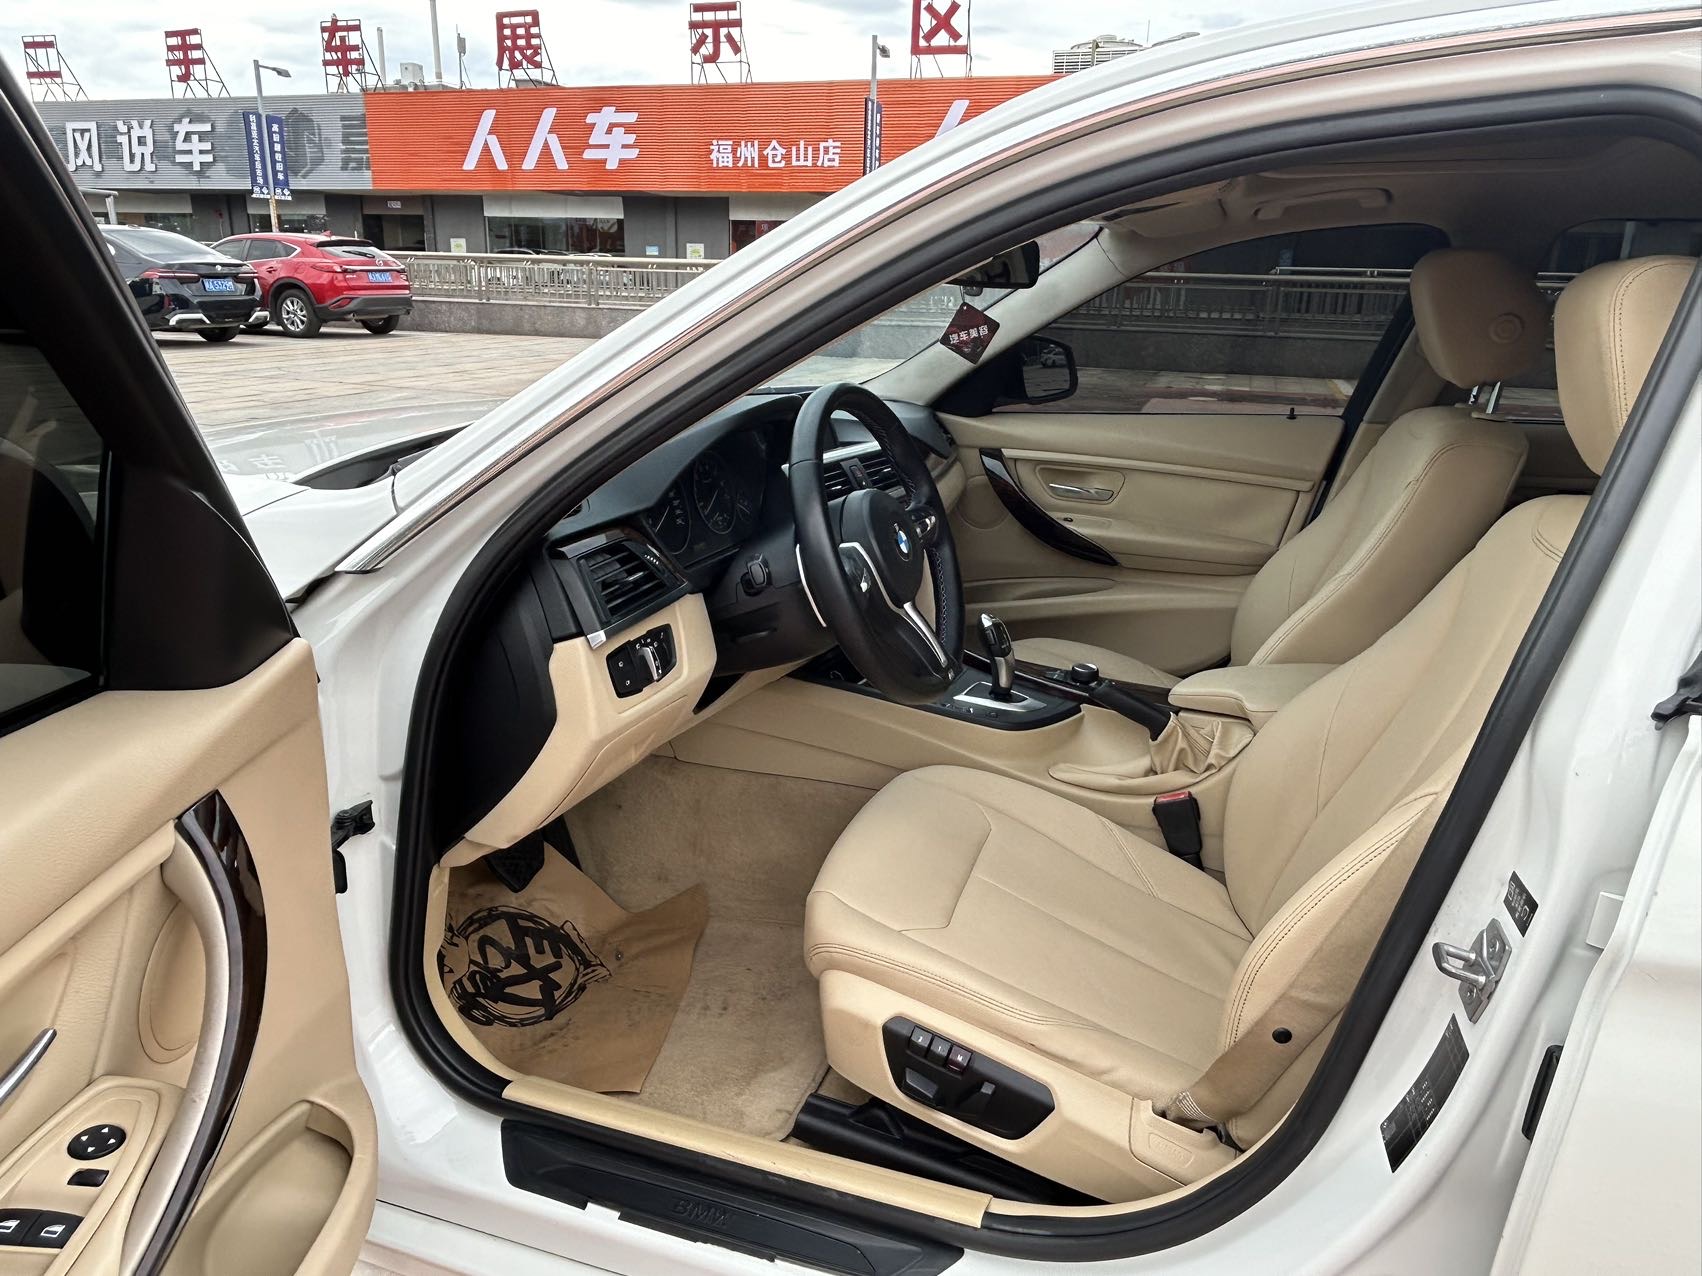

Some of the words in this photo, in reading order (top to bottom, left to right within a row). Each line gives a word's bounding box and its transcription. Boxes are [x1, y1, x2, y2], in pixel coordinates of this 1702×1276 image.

[65, 118, 214, 172] 风说车
[462, 106, 640, 170] 人人车
[709, 138, 842, 168] 福州仓山店
